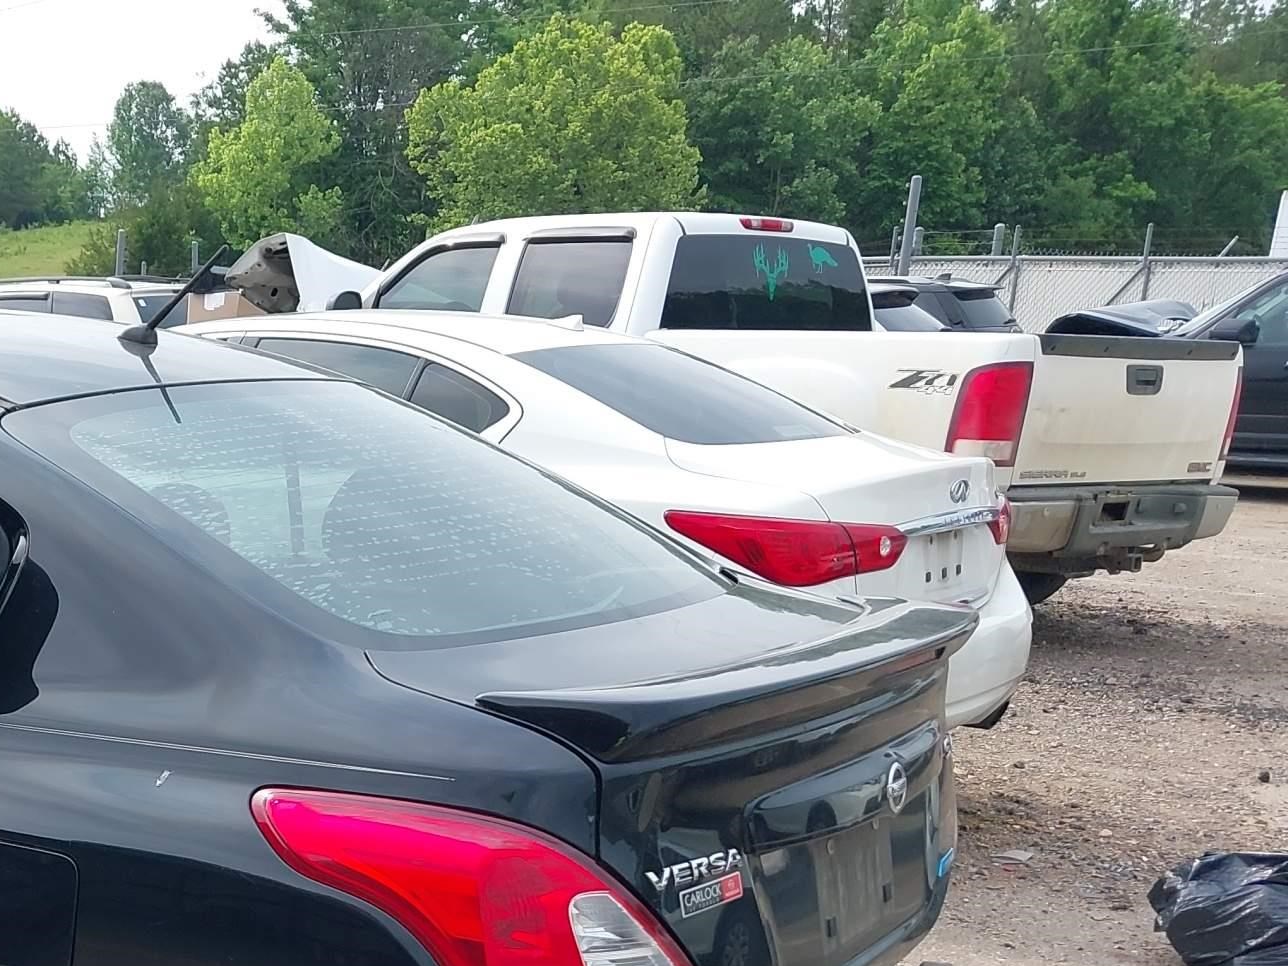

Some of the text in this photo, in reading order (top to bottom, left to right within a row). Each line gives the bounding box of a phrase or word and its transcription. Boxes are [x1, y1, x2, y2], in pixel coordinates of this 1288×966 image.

[888, 369, 958, 388] Z71
[644, 848, 744, 891] VERSA
[684, 883, 722, 906] CARLOCK
